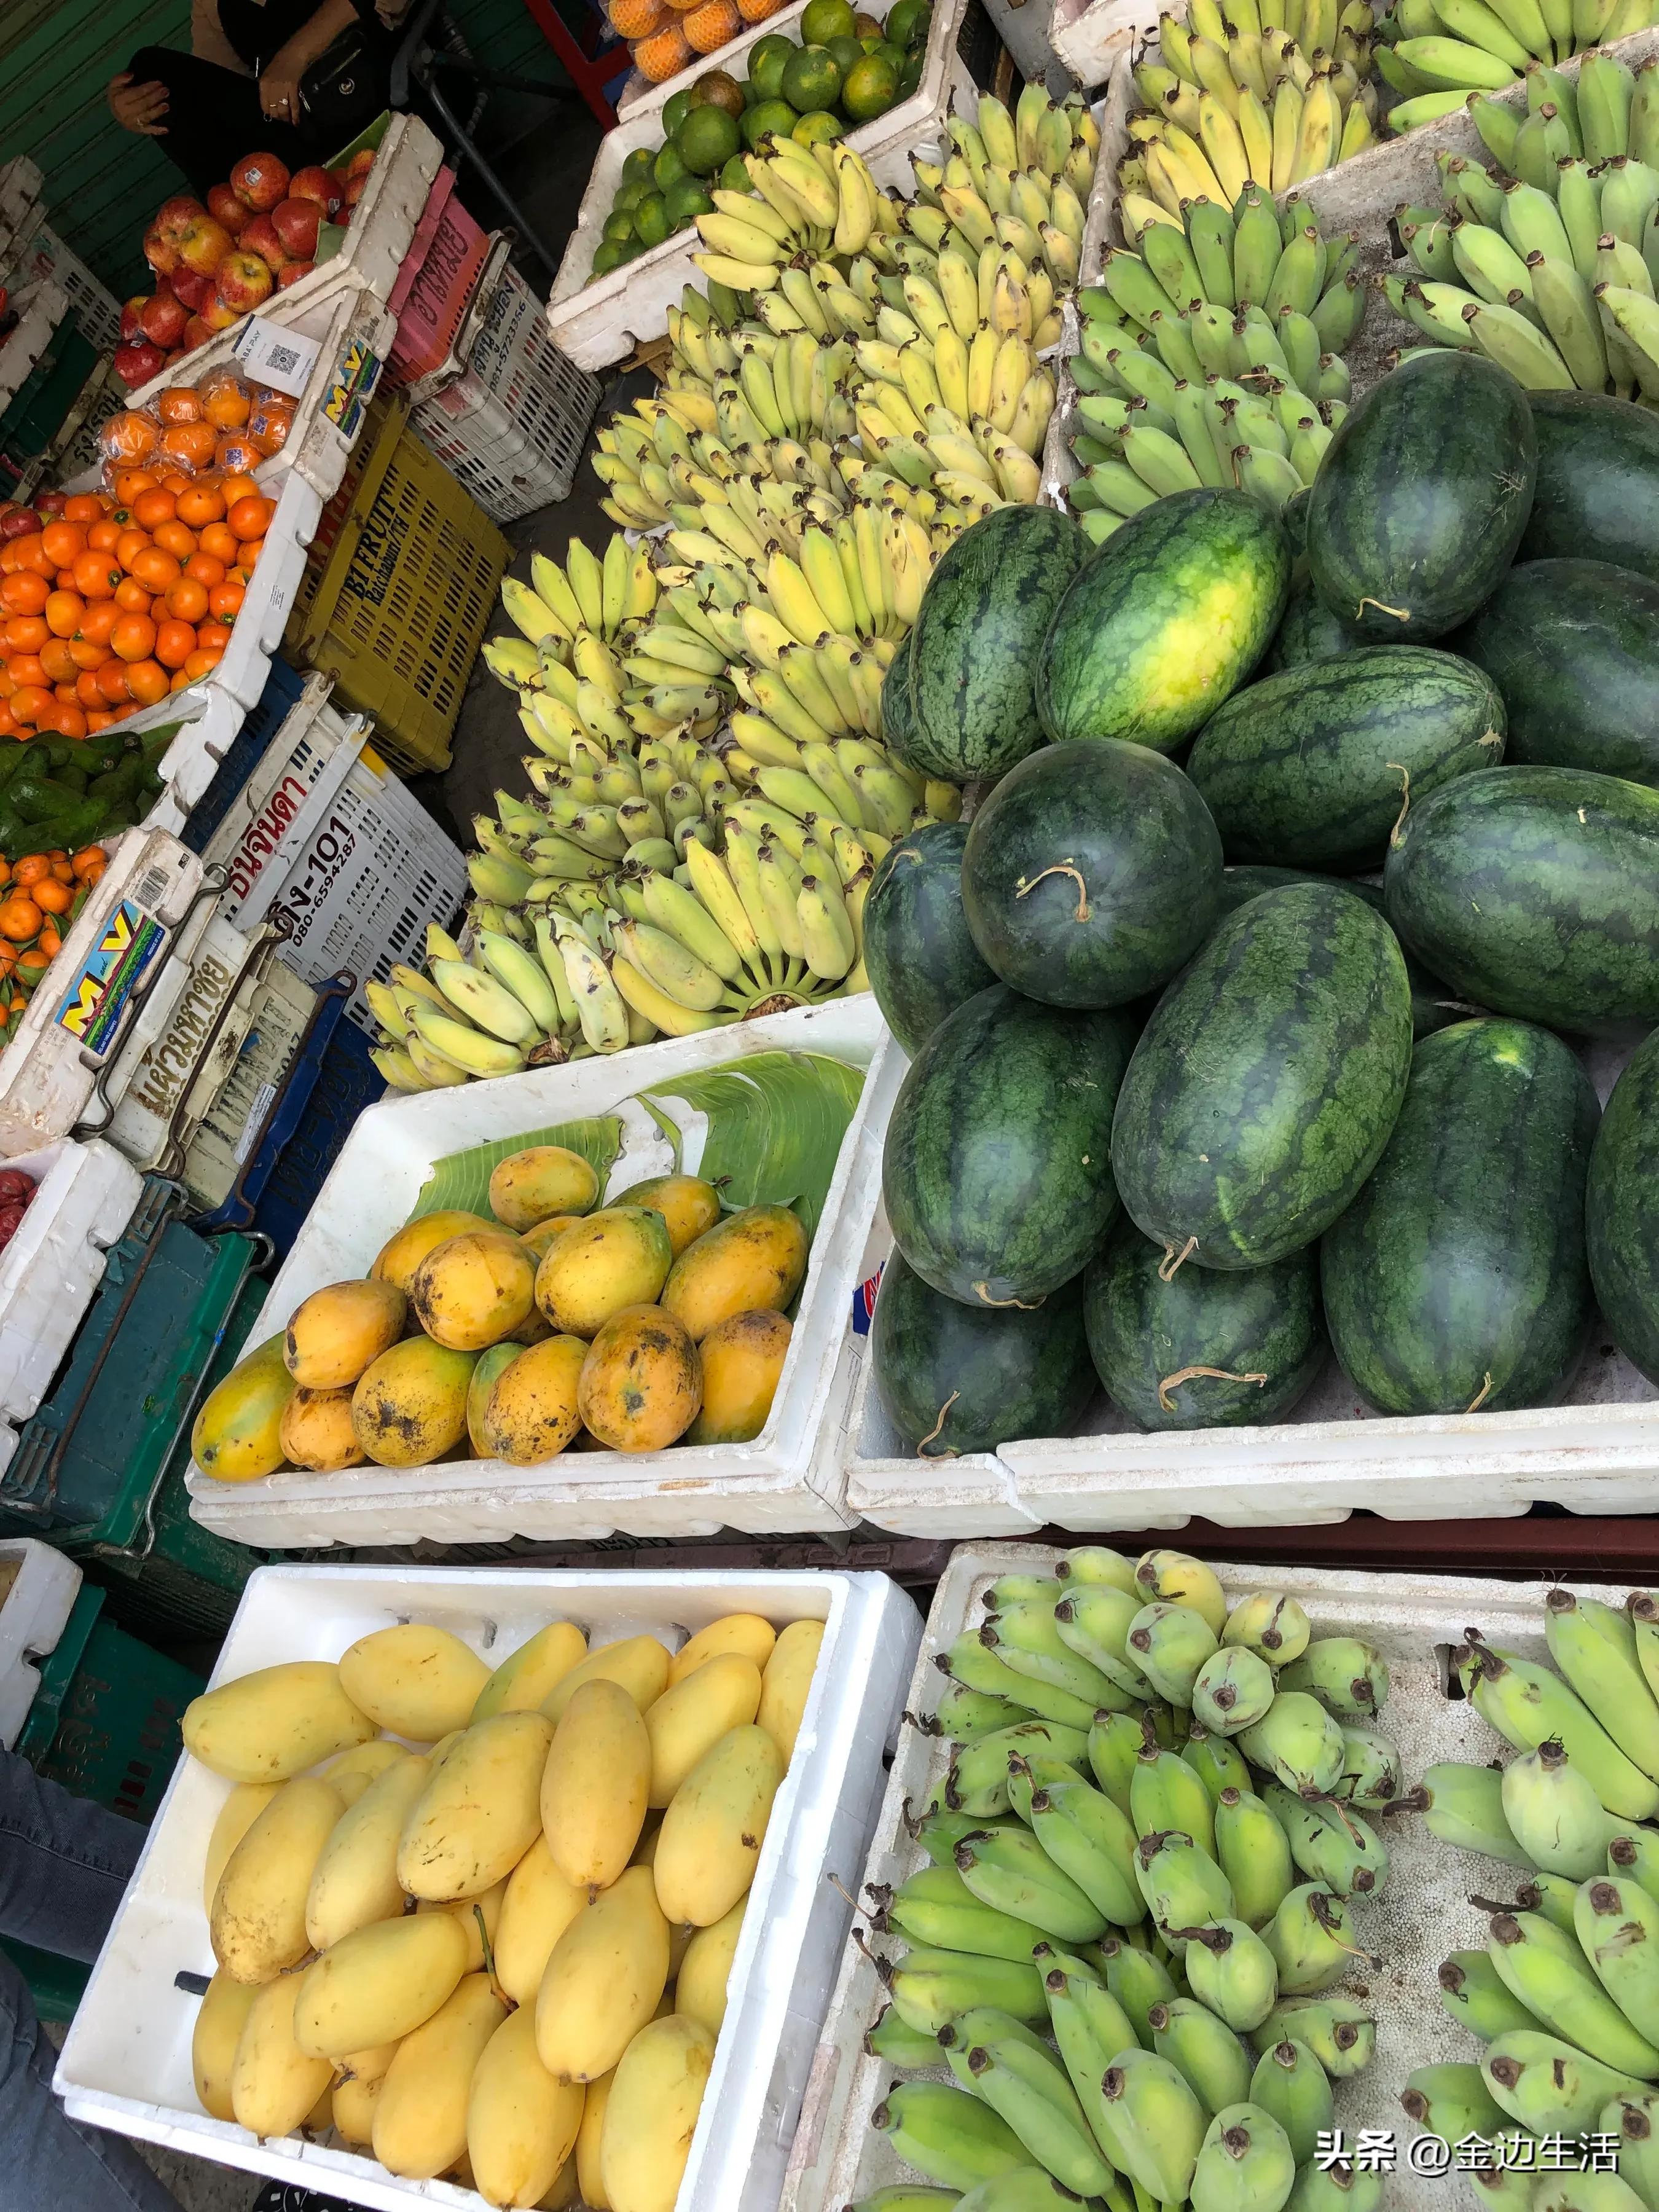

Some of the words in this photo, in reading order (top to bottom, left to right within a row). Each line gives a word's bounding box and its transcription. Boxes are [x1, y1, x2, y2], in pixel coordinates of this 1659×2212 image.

[249, 329, 259, 347] PAY
[354, 490, 396, 570] FRUIT
[292, 833, 357, 947] 080-6594287
[98, 904, 137, 953] V
[147, 942, 157, 956] PRODUCE
[98, 957, 109, 976] and
[60, 970, 106, 1038] M
